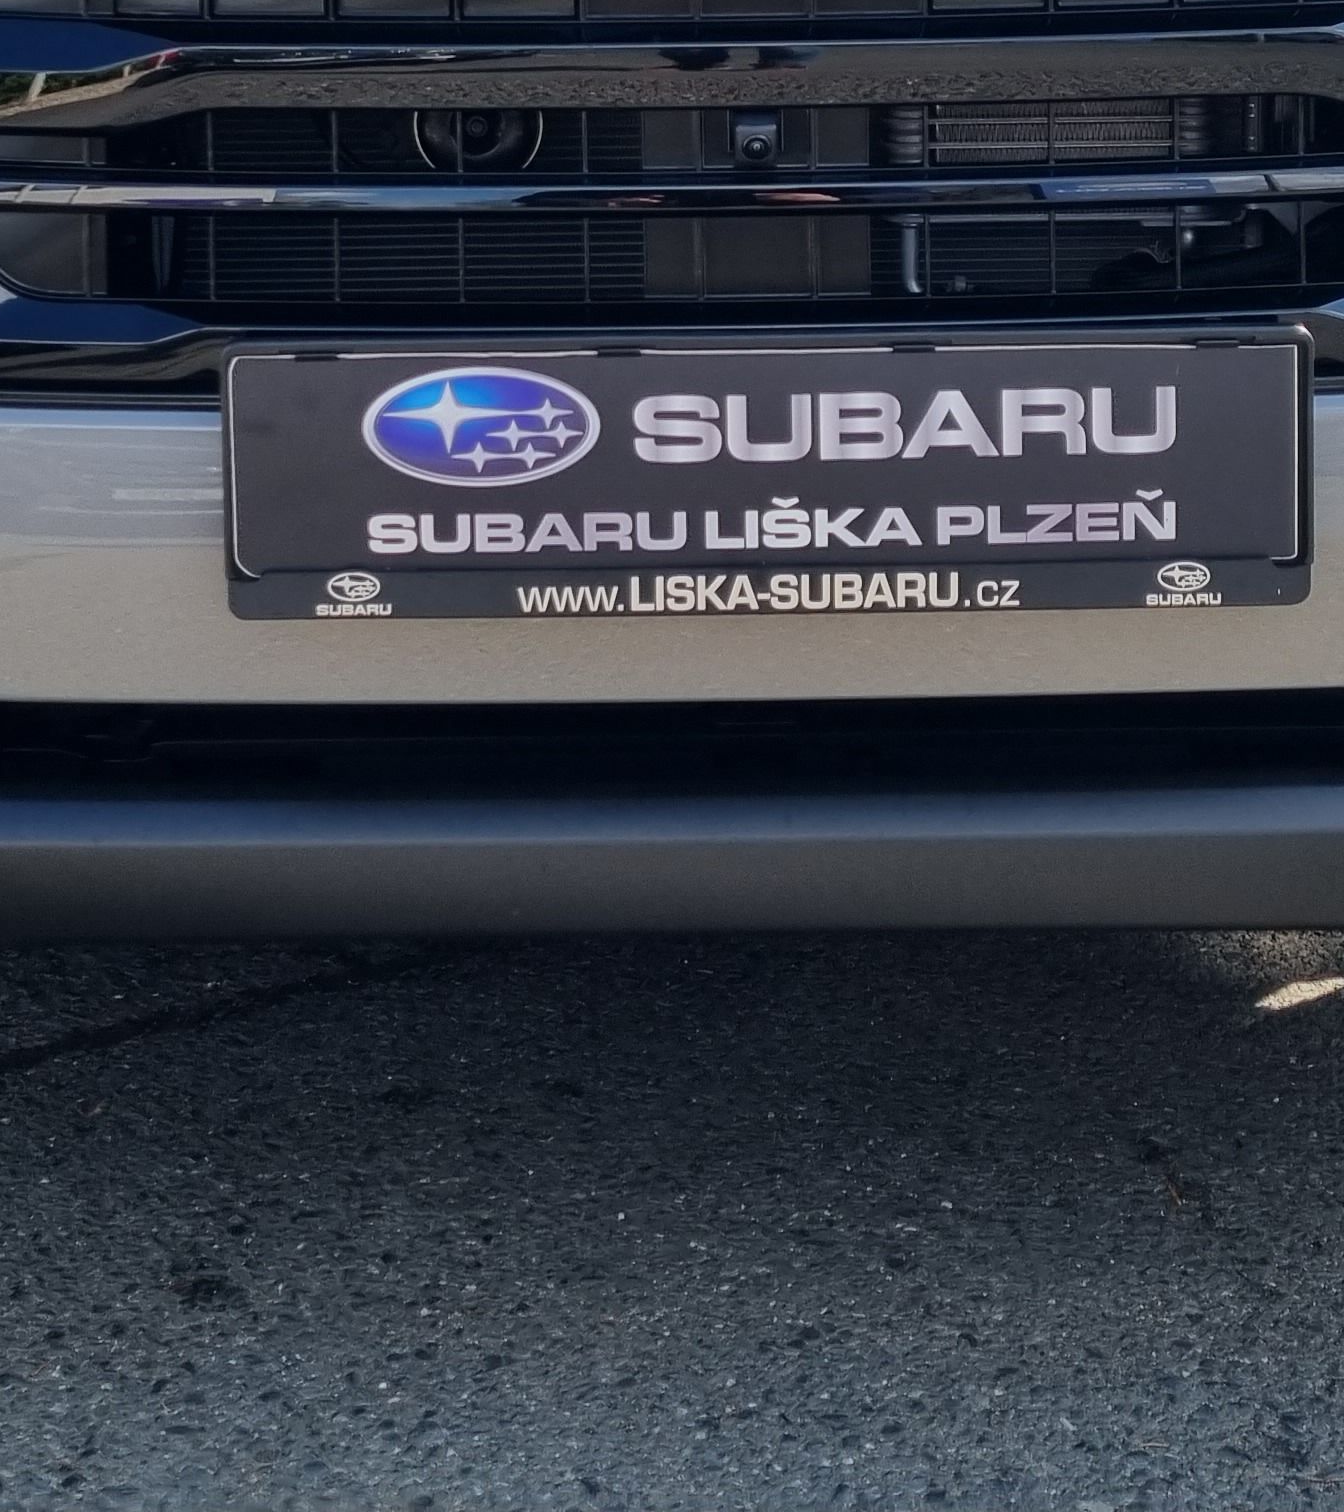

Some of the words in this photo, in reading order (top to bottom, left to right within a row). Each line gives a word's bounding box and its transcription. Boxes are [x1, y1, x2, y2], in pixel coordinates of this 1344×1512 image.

[633, 385, 1177, 463] SUBARU
[367, 510, 687, 554] SUBARU
[705, 496, 922, 550] LIŠKA
[936, 488, 1177, 546] PLZEŇ
[315, 603, 392, 617] SUBARU
[517, 571, 1020, 614] www.LISKA-SUBARU.cz
[1146, 592, 1222, 606] SUBARU
